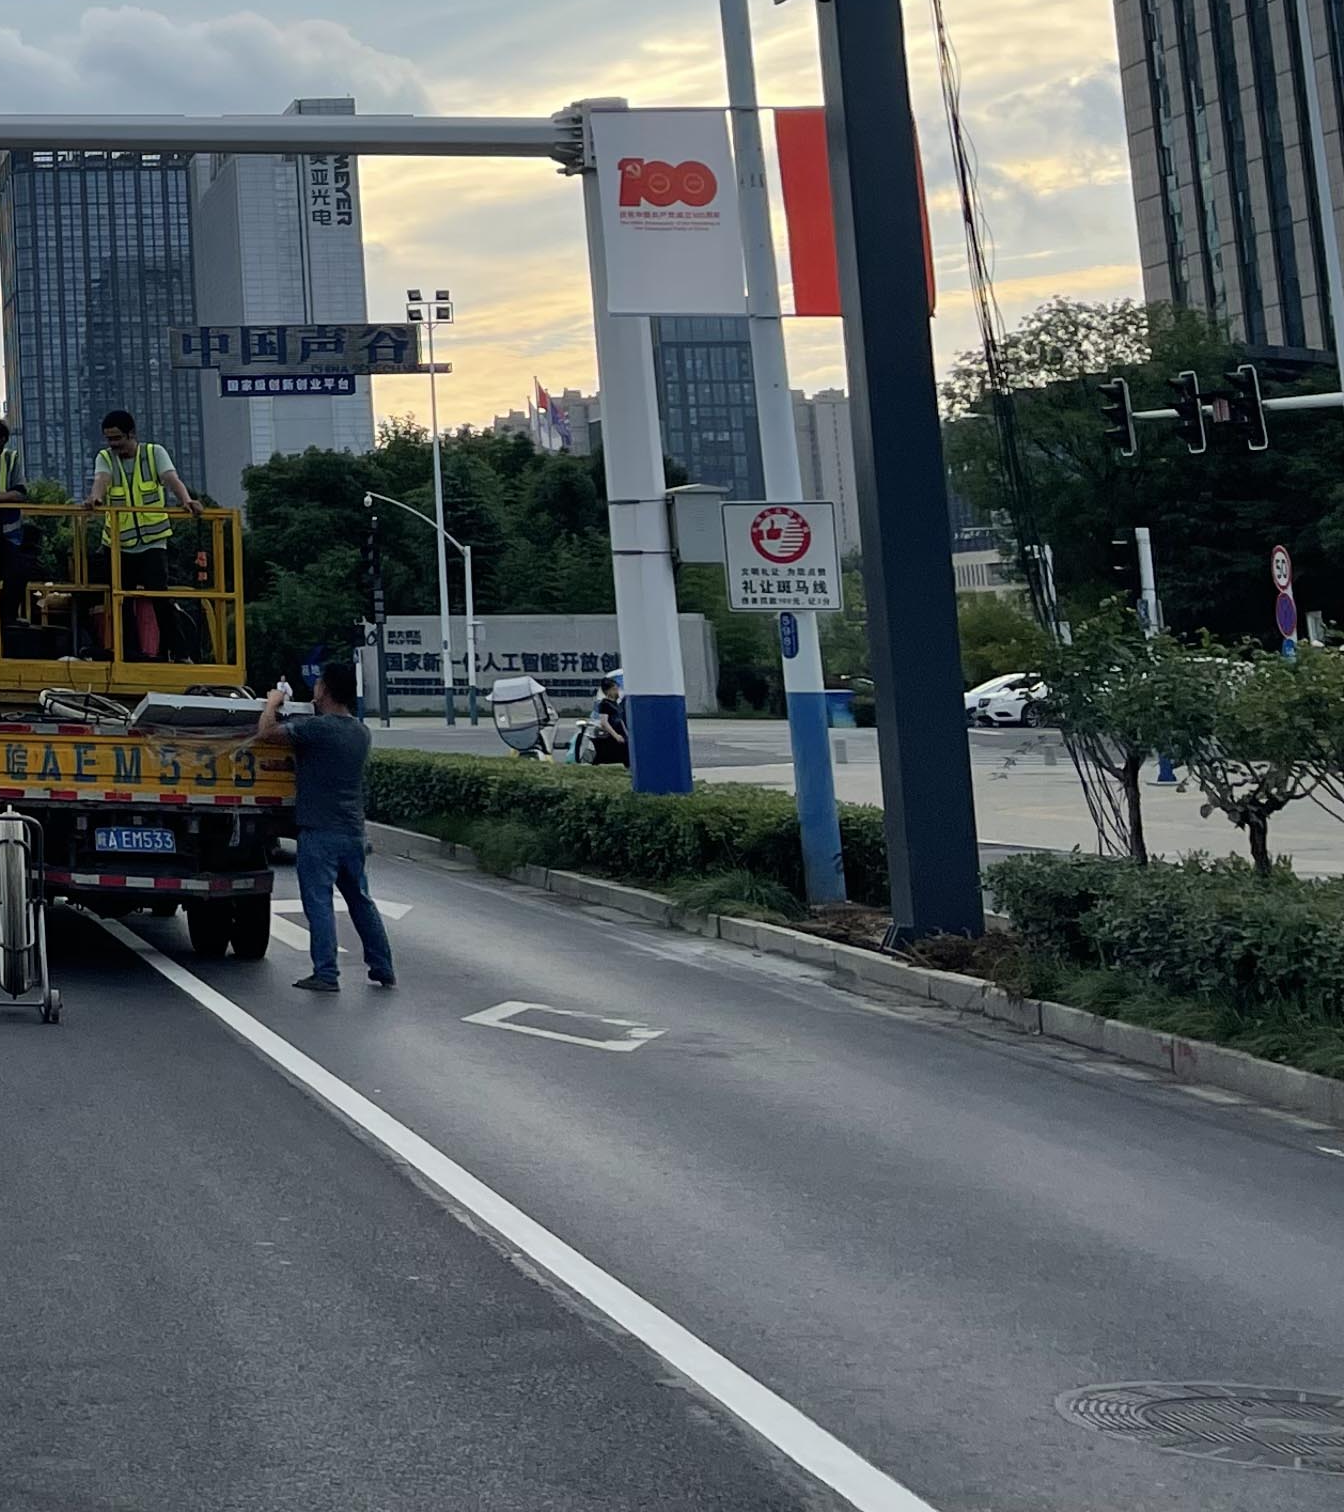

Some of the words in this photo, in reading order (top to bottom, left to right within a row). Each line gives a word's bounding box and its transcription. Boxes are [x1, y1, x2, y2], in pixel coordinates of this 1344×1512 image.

[181, 325, 409, 369] 中国声谷
[1275, 558, 1288, 579] 50
[741, 579, 828, 595] 礼让斑马线
